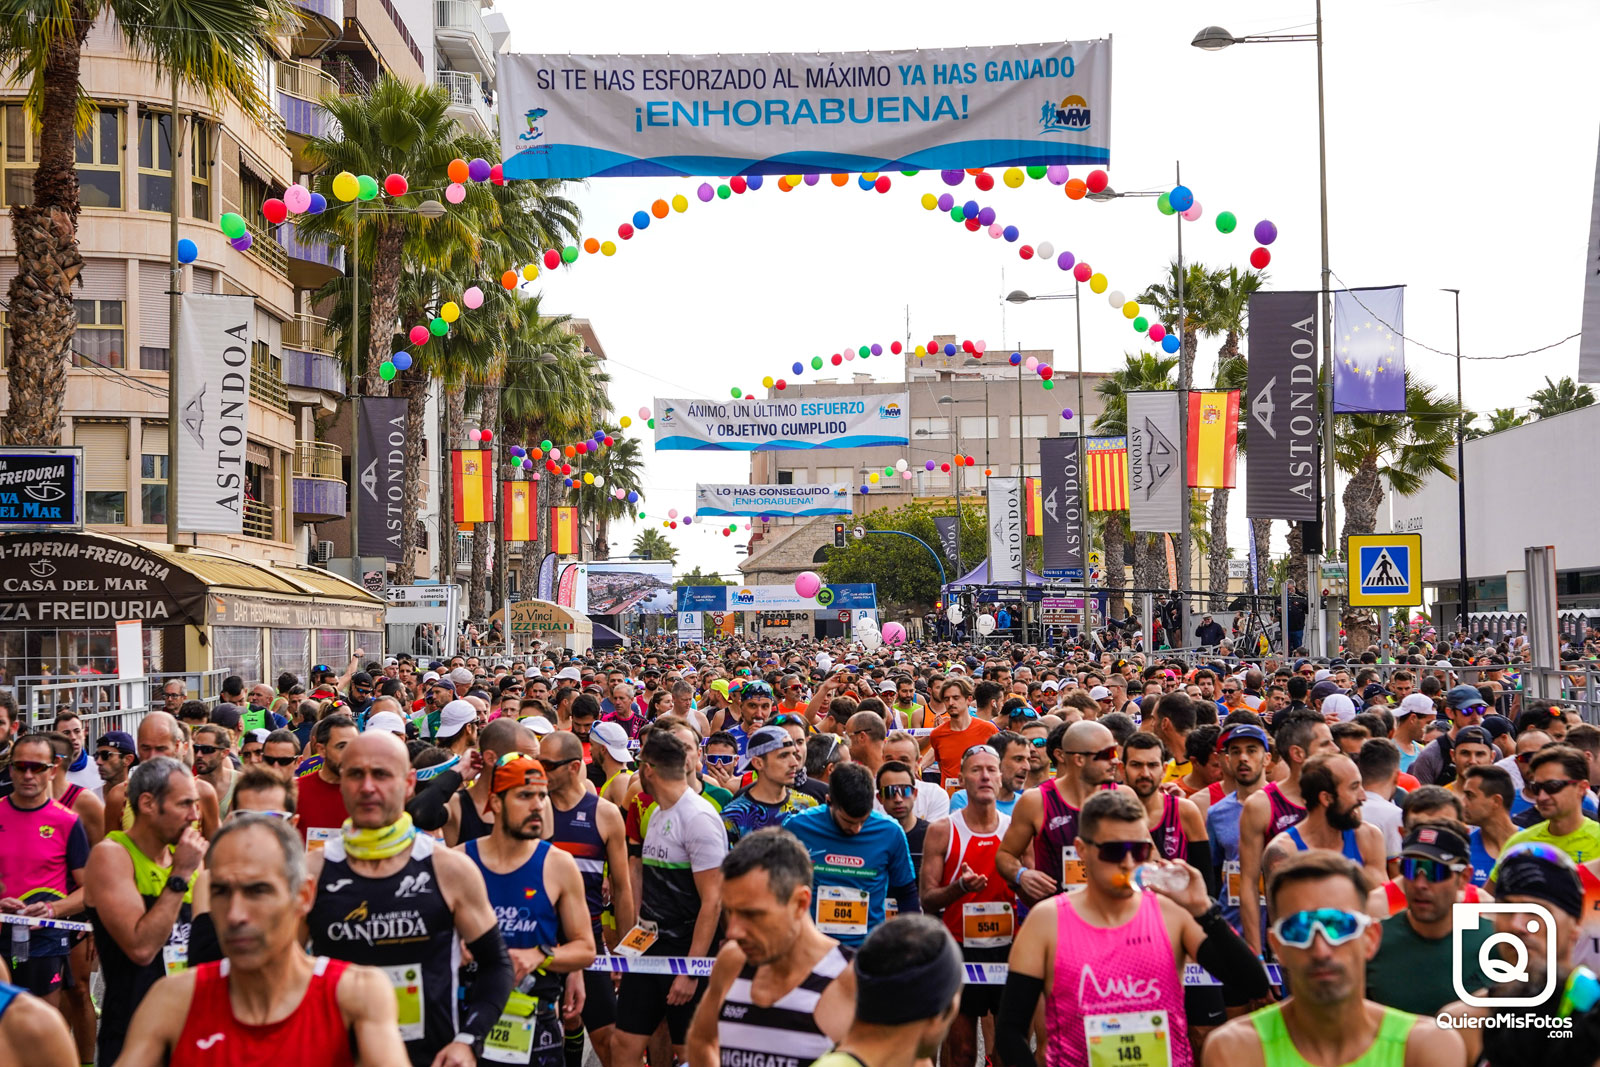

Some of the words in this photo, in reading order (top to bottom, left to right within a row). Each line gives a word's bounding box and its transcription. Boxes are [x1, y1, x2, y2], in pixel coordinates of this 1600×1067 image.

[537, 69, 555, 90] SI
[561, 69, 587, 90] TE
[594, 69, 635, 91] HAS
[643, 68, 767, 91] ESFORZADO
[773, 67, 799, 89] AL
[806, 62, 891, 89] MÁXIMO
[898, 65, 926, 86] YA
[933, 63, 978, 85] HAS
[984, 56, 1075, 83] GANADO
[635, 94, 969, 133] ¡ENHORABUENA!
[216, 320, 249, 515] ASTONDOA
[687, 402, 731, 420] ÁNIMO,
[733, 405, 750, 418] UN
[753, 402, 797, 418] ÚLTIMO
[801, 400, 865, 416] ESFUERZO
[1288, 313, 1315, 502] ASTONDOA
[706, 424, 715, 436] Y
[717, 423, 778, 437] OBJETIVO
[781, 421, 848, 436] CUMPLIDO
[1131, 425, 1143, 493] ASTONDOA
[0, 464, 65, 486] FREIDURIA
[386, 414, 406, 549] ASTONDOA
[716, 488, 731, 496] LO
[734, 488, 756, 496] HAS
[759, 487, 830, 496] CONSEGUIDO
[732, 497, 814, 507] ¡ENHORABUENA!
[1064, 450, 1081, 559] ASTONDOA
[1009, 487, 1022, 573] ASTONDOA
[38, 600, 169, 621] FREIDURIA
[234, 602, 248, 622] BAR
[526, 609, 553, 621] Vinci
[506, 622, 561, 631] IZZERIA
[828, 855, 861, 866] ADRIAN
[834, 908, 852, 919] 604
[327, 917, 428, 947] CANDIDA
[498, 918, 538, 932] TEAM
[978, 922, 999, 932] 5541
[1184, 965, 1204, 974] ICIA
[490, 1029, 510, 1042] 128
[1117, 1046, 1142, 1061] 148
